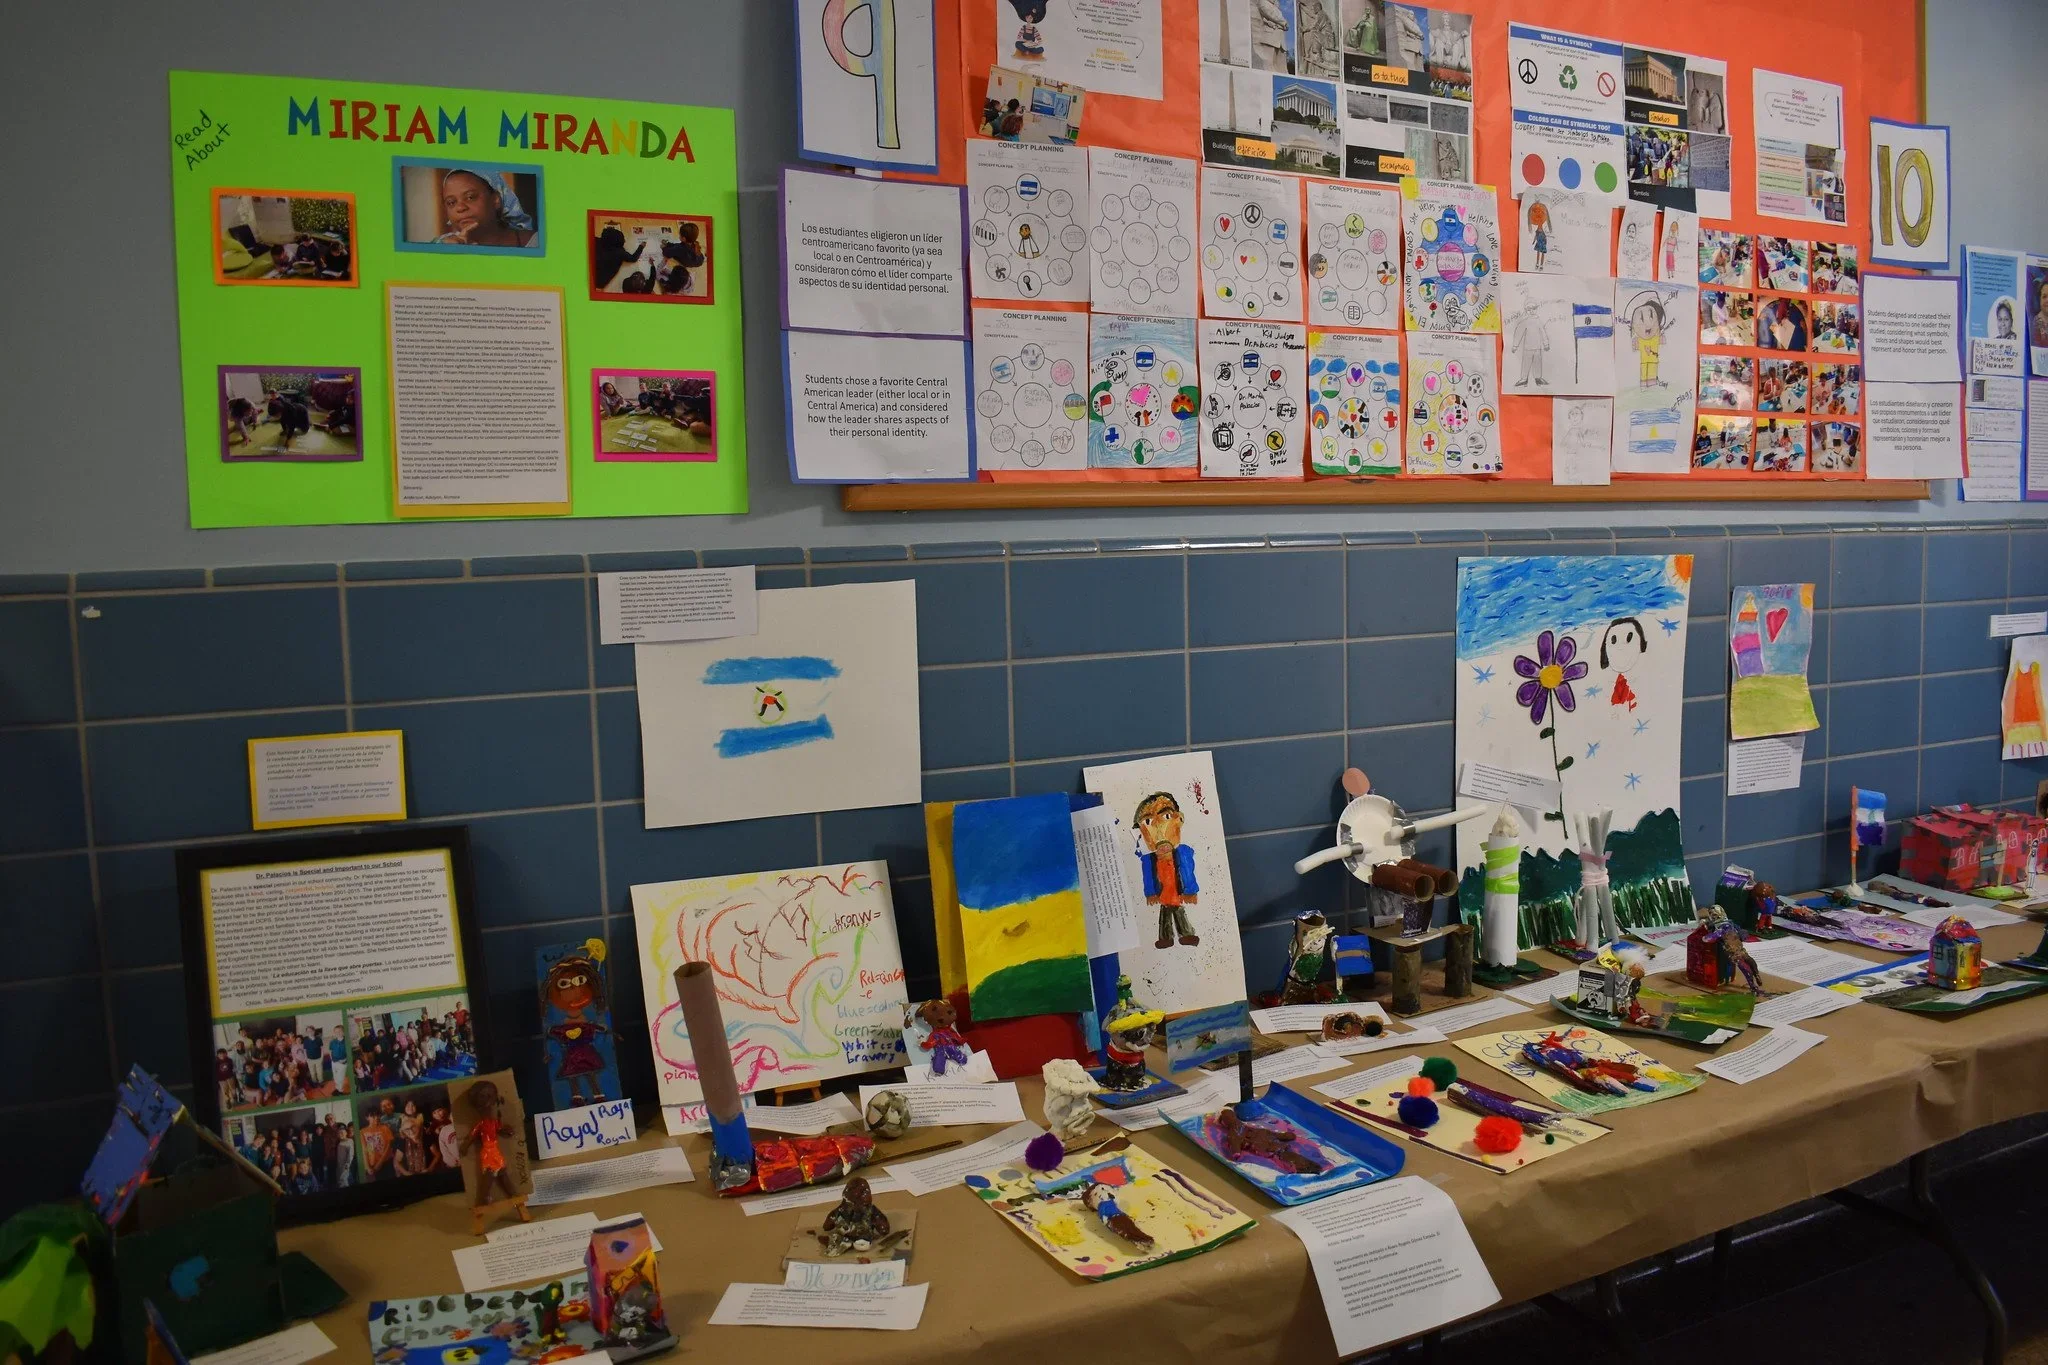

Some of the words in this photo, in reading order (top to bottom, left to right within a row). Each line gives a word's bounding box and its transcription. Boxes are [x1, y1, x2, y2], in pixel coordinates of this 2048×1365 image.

[1528, 114, 1549, 124] COLORS
[174, 109, 212, 150] Read
[288, 96, 468, 145] MIRIAM
[498, 110, 696, 163] MIRANDA
[186, 123, 230, 171] About
[997, 142, 1028, 151] CONCEPT
[1030, 144, 1064, 153] PLANNING
[1114, 152, 1142, 162] CONCEPT
[1142, 156, 1173, 166] PLANNING
[1353, 157, 1376, 166] Sculpture
[1227, 172, 1254, 181] CONCEPT
[1255, 176, 1281, 185] PLANNING
[1329, 185, 1352, 193] CONCEPT
[1353, 188, 1381, 197] PLANNING
[1427, 181, 1450, 189] CONCEPT
[1450, 183, 1474, 191] PLANNING
[1877, 144, 1934, 248] 10
[801, 223, 818, 234] Los
[819, 226, 869, 239] estudiantes
[870, 230, 908, 242] eligieron
[909, 234, 921, 242] un
[922, 233, 943, 243] líder
[801, 237, 875, 252] centroamericano
[876, 243, 910, 255] favorito
[912, 247, 925, 256] (ya
[926, 248, 943, 256] sea
[813, 250, 834, 261] local
[843, 255, 854, 263] en
[855, 255, 925, 269] Centroamérica)
[927, 260, 932, 270] y
[794, 263, 850, 276] consideraron
[851, 266, 877, 278] cómo
[878, 270, 887, 278] el
[888, 270, 908, 279] líder
[910, 272, 953, 282] comparte
[798, 276, 838, 289] aspectos
[839, 279, 850, 289] de
[851, 282, 863, 290] su
[864, 281, 907, 292] identidad
[908, 284, 949, 294] personal.
[1003, 313, 1032, 321] CONCEPT
[1033, 315, 1067, 323] PLANNING
[1117, 315, 1145, 323] CONCEPT
[1146, 317, 1176, 326] PLANNING
[1868, 310, 1886, 318] Students
[1887, 311, 1907, 320] designed
[1253, 322, 1281, 330] PLANNING
[1332, 334, 1358, 342] CONCEPT
[1431, 333, 1454, 341] CONCEPT
[1454, 335, 1478, 343] PLANNING
[1887, 329, 1913, 337] considering
[805, 374, 843, 385] Students
[845, 375, 870, 386] chose
[872, 378, 878, 386] a
[879, 376, 914, 387] favorite
[916, 377, 948, 387] Central
[803, 387, 844, 398] American
[845, 388, 874, 399] leader
[875, 390, 906, 400] (either
[907, 390, 928, 399] local
[942, 390, 951, 399] in
[807, 400, 838, 411] Central
[839, 401, 879, 413] America)
[880, 402, 898, 412] and
[899, 403, 948, 412] considered
[807, 413, 826, 423] how
[828, 414, 842, 424] the
[844, 414, 871, 424] leader
[873, 415, 903, 424] shares
[904, 415, 938, 426] aspects
[939, 415, 949, 425] of
[829, 427, 849, 437] their
[851, 427, 890, 439] personal
[891, 427, 928, 439] identity.
[1930, 436, 1946, 444] mejor
[256, 872, 266, 880] Dr.
[266, 871, 292, 879] Palacios
[300, 867, 322, 877] Special
[323, 866, 334, 875] and
[335, 863, 363, 873] Important
[382, 860, 403, 869] School
[542, 1110, 599, 1149] Royal
[596, 1127, 631, 1146] Royal
